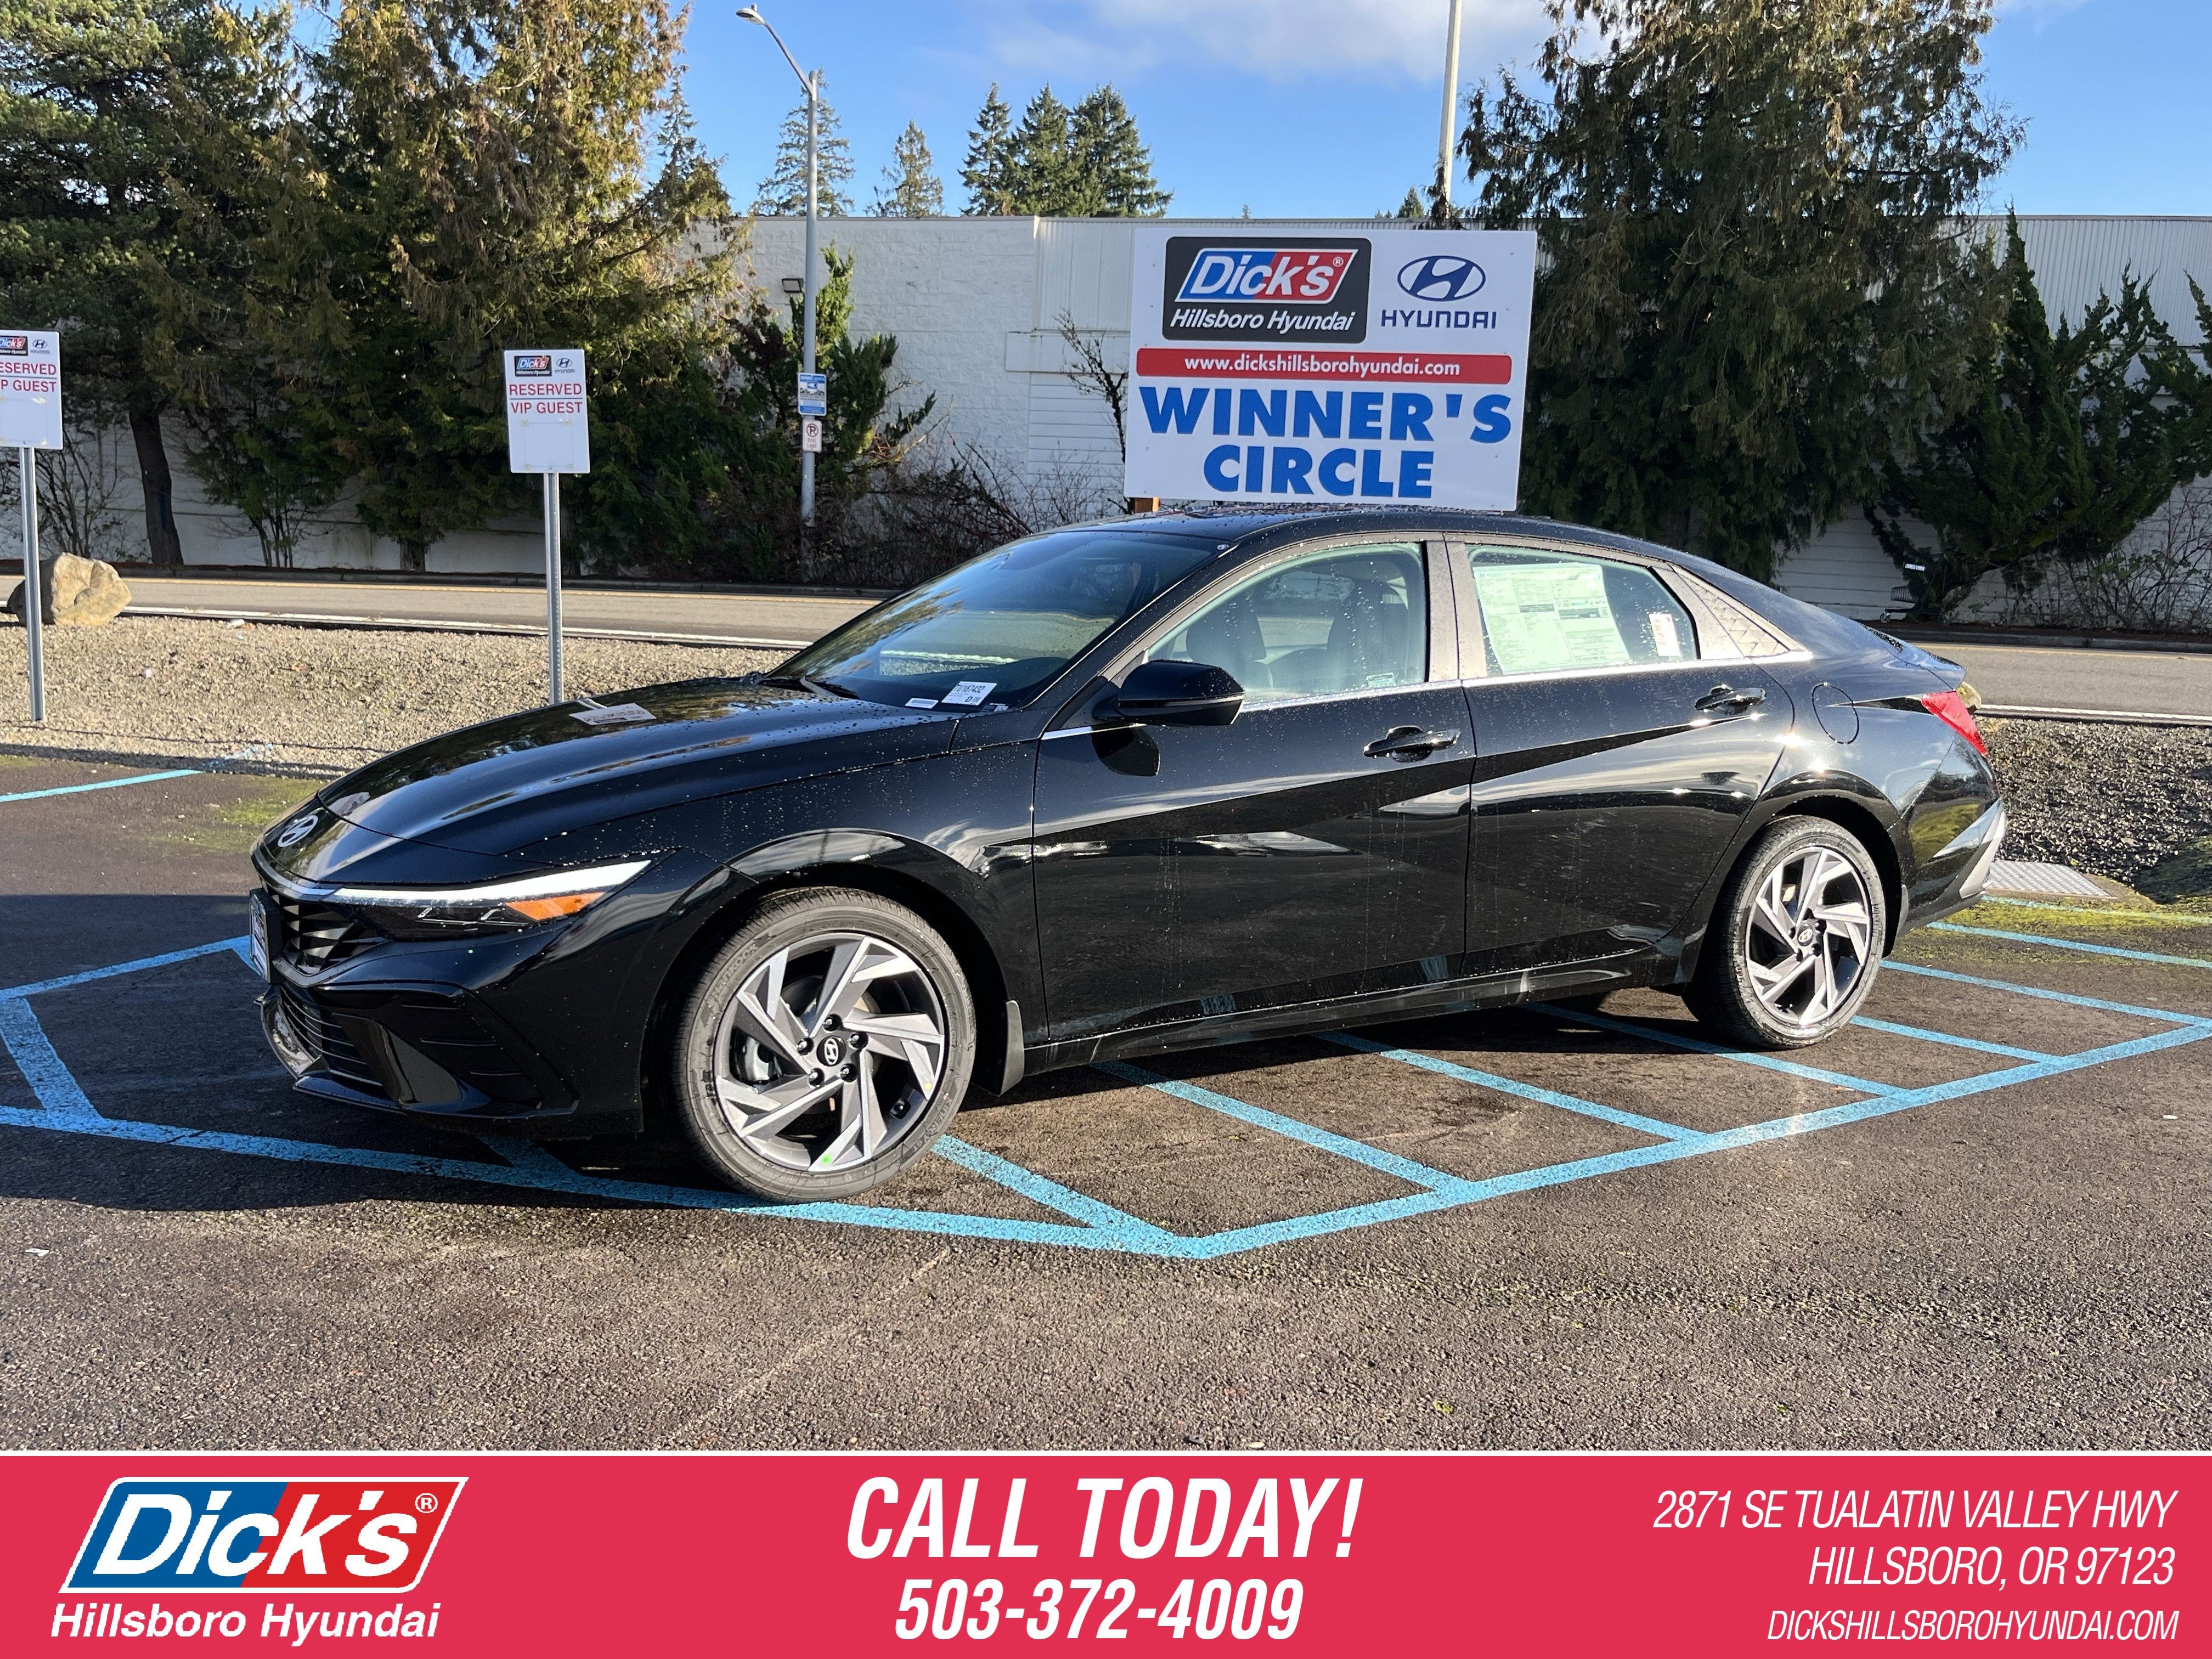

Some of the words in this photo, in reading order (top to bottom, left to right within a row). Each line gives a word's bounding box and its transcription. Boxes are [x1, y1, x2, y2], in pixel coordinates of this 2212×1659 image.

[1190, 255, 1334, 296] Dick's
[1170, 308, 1264, 329] Hillsboro
[1267, 311, 1356, 334] Hyundai
[1381, 309, 1497, 329] HYUNDAI
[0, 362, 57, 375] ESERVED
[1184, 354, 1460, 377] www.dickshillsborohyundai.com
[13, 380, 57, 392] GUEST
[509, 383, 582, 396] RESERVED
[511, 403, 532, 414] VIP
[537, 402, 583, 414] GUEST
[1139, 386, 1511, 443] WINNER'S
[1204, 444, 1434, 498] CIRCLE
